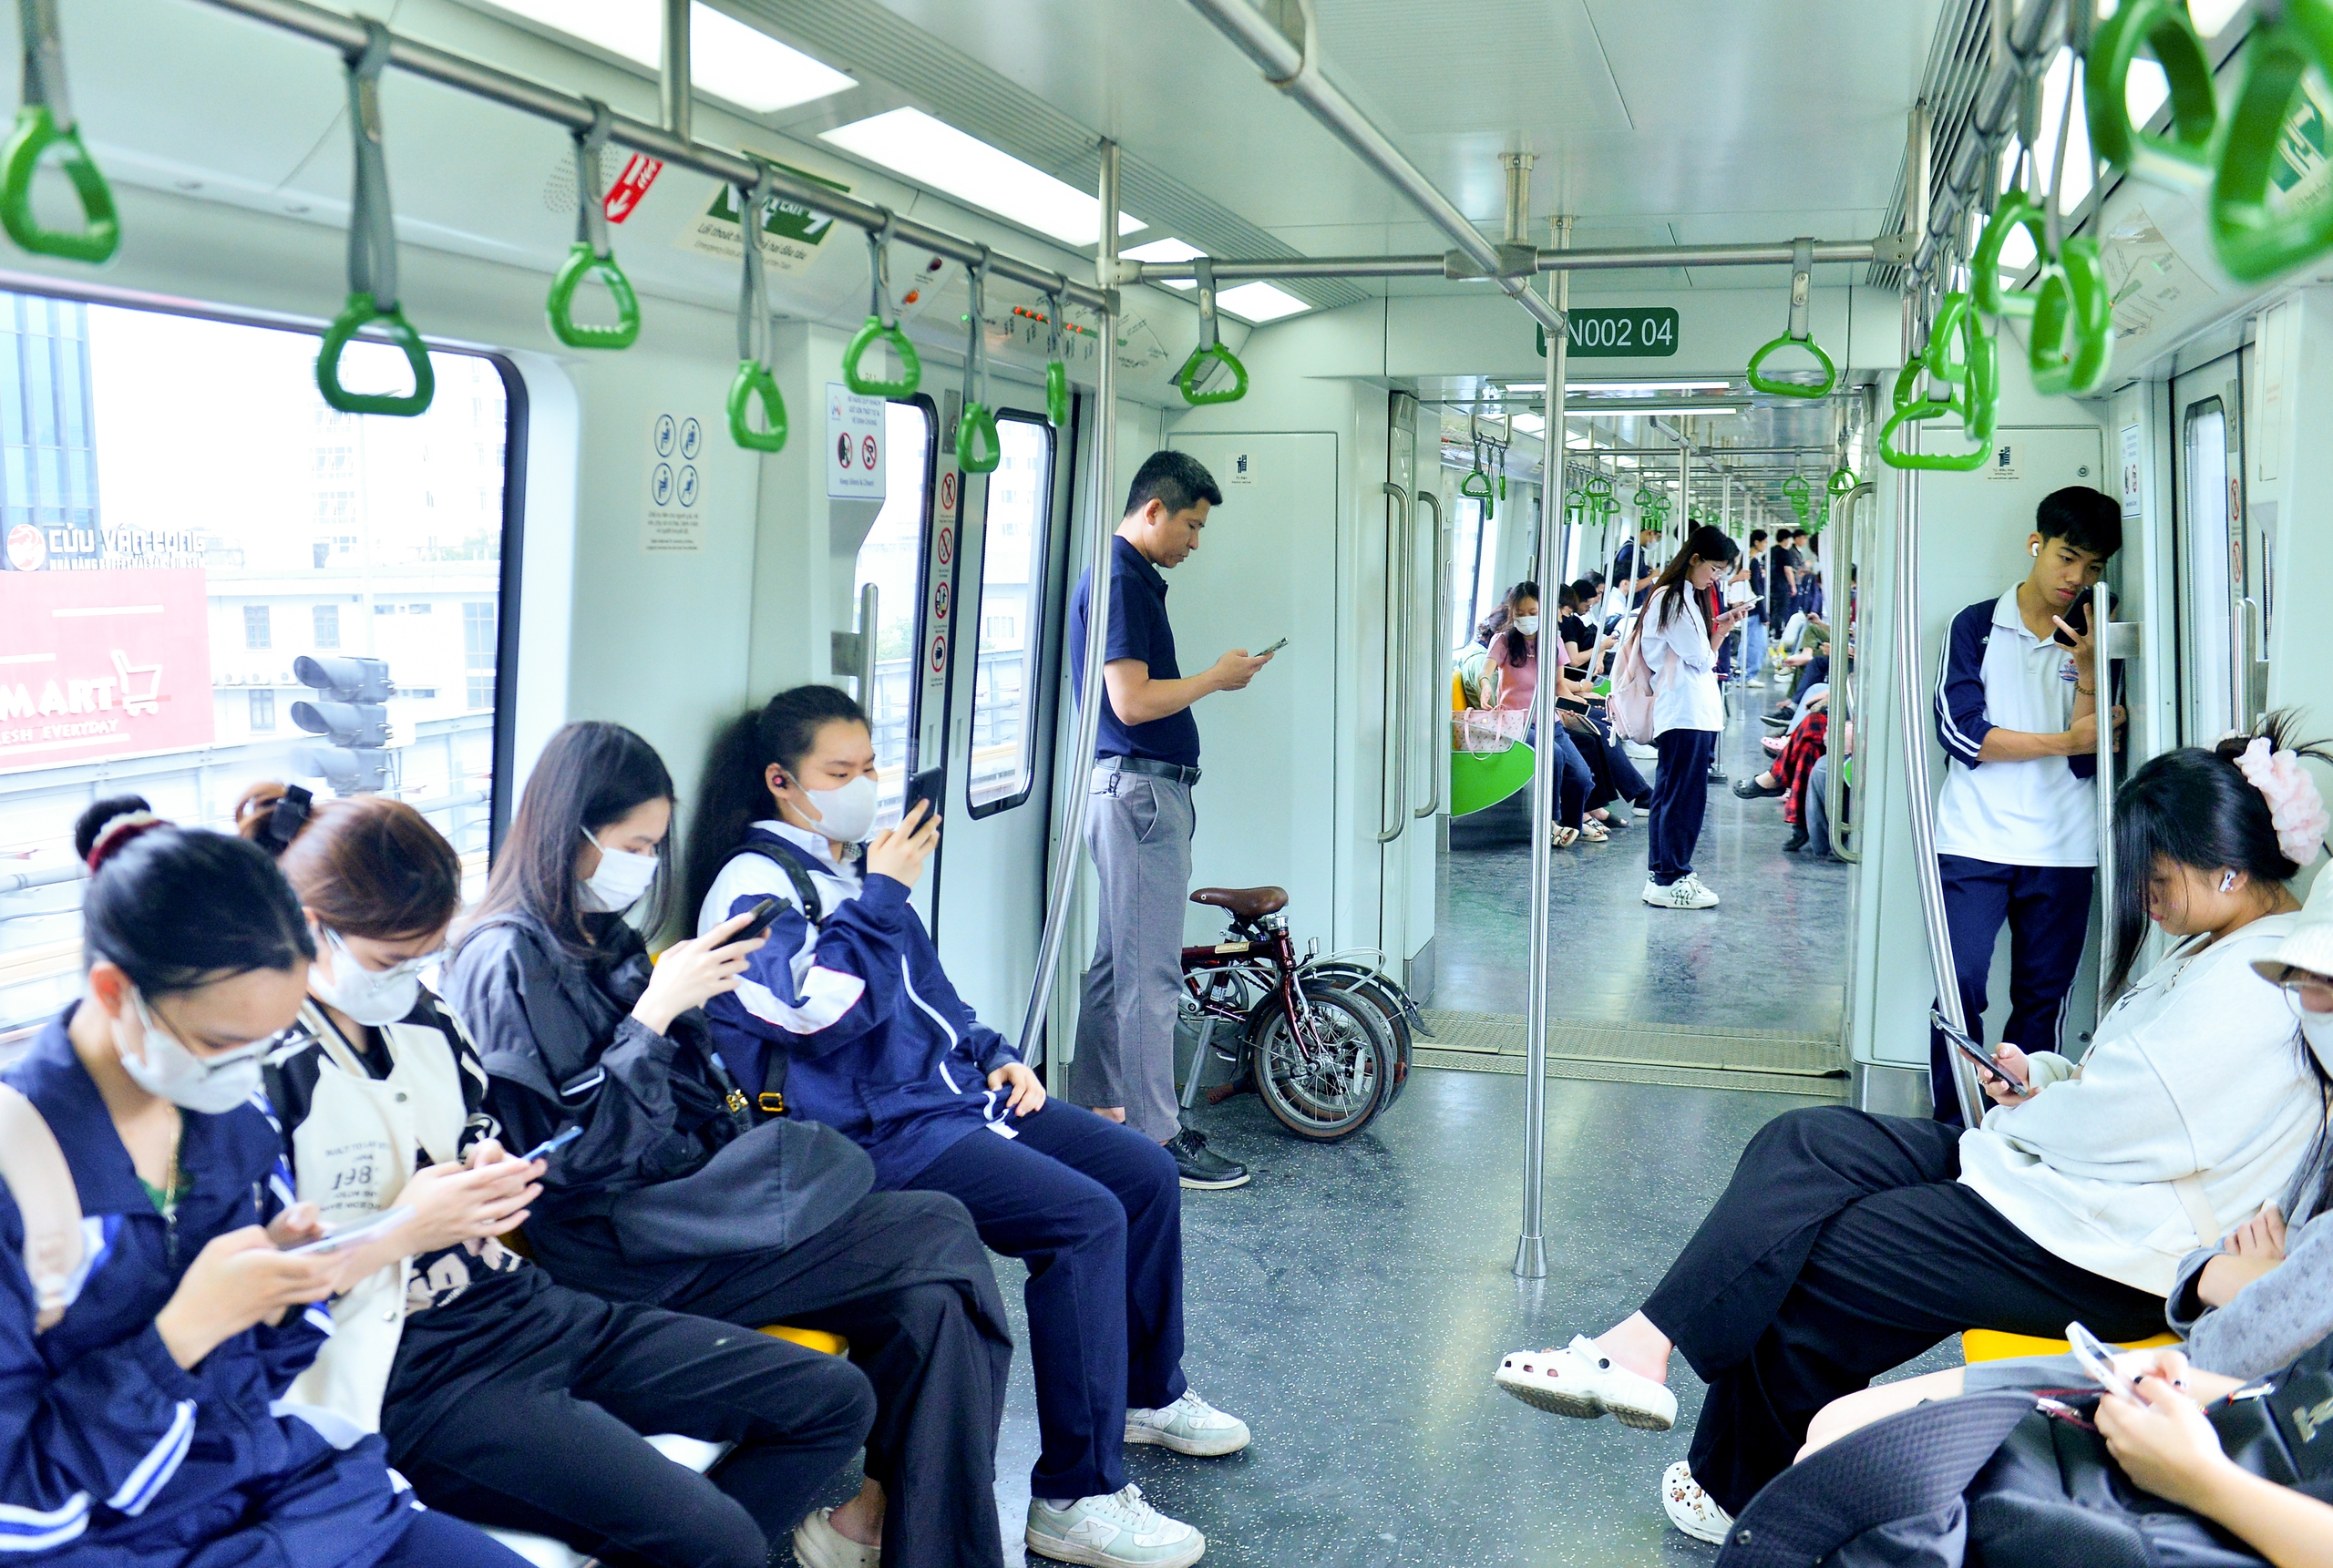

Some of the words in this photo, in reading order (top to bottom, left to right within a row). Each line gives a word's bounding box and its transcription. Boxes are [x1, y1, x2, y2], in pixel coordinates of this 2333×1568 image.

[1544, 318, 1633, 347] N002
[1641, 318, 1673, 346] 04
[0, 676, 118, 722] MART
[0, 728, 33, 746] ESH
[43, 718, 118, 740] EVERYDAY
